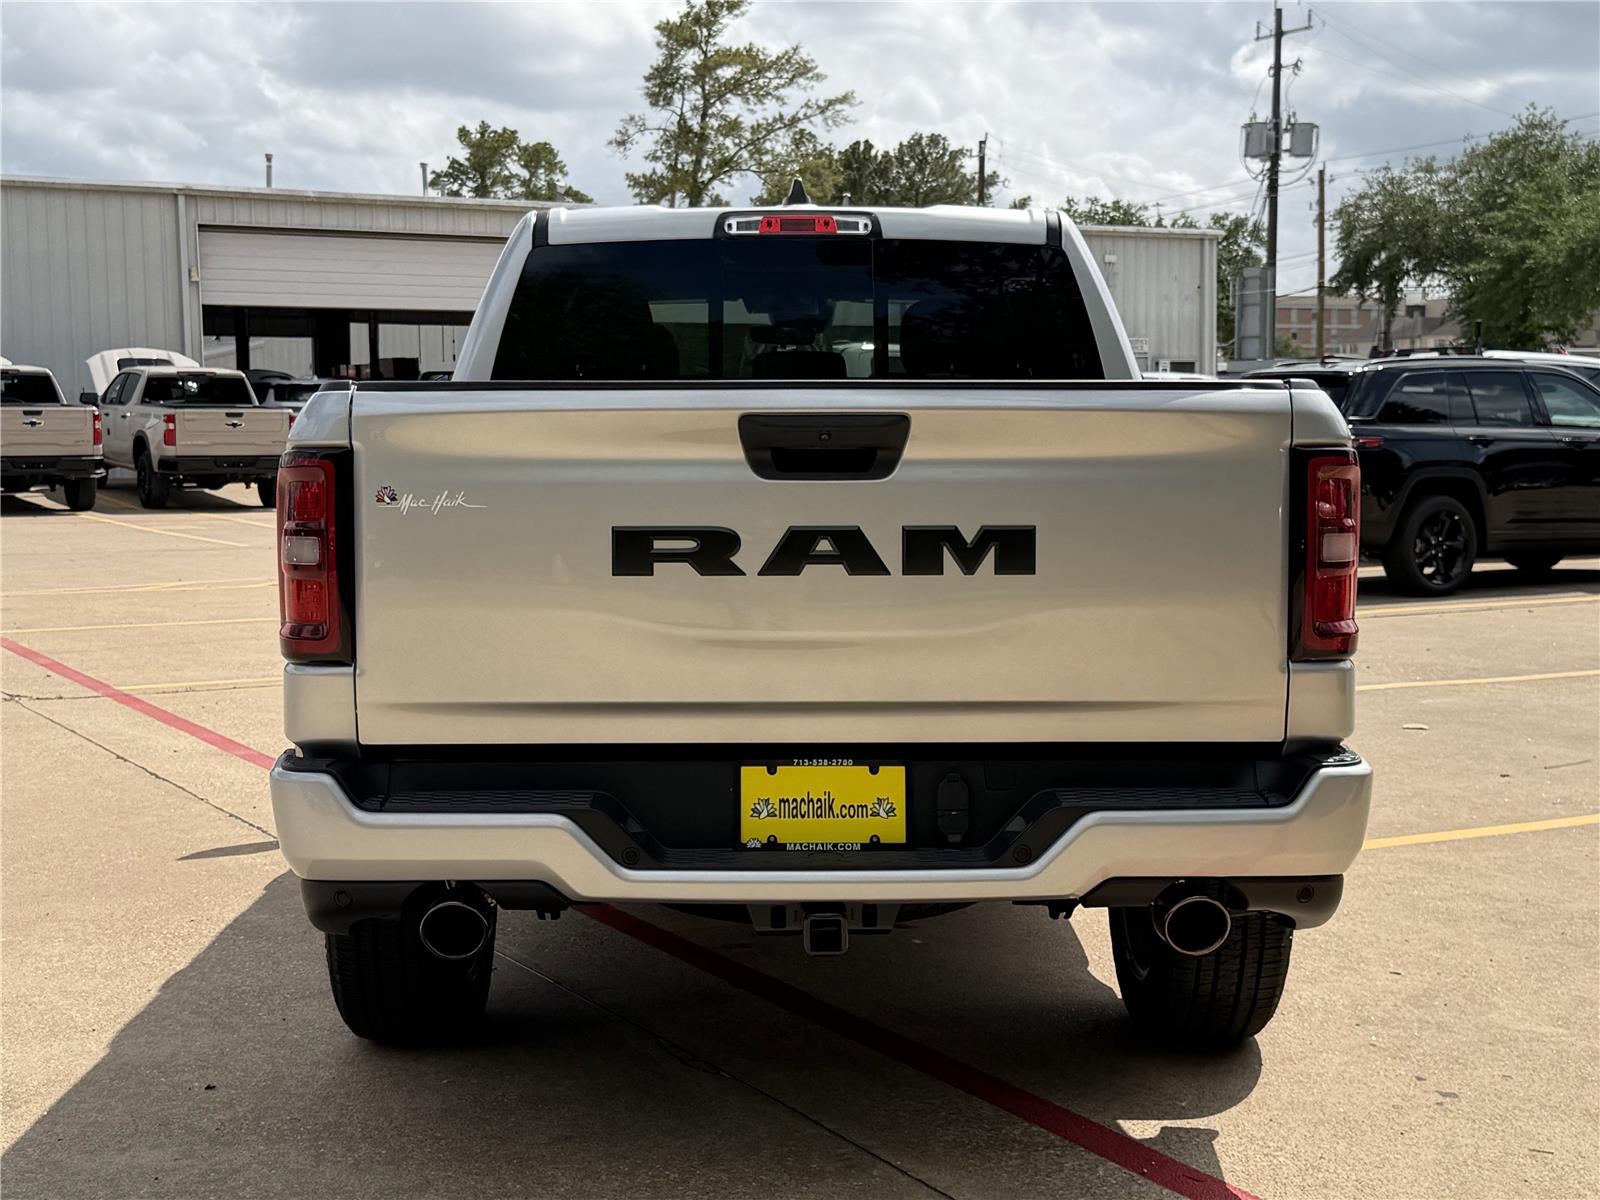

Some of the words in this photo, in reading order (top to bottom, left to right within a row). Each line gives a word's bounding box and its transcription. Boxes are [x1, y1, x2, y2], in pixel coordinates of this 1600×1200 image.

[396, 492, 432, 516] Mac
[431, 490, 478, 516] Haik
[612, 525, 1036, 576] RAM
[778, 791, 869, 819] machaik.com
[786, 843, 861, 851] MACHAIK.COM
